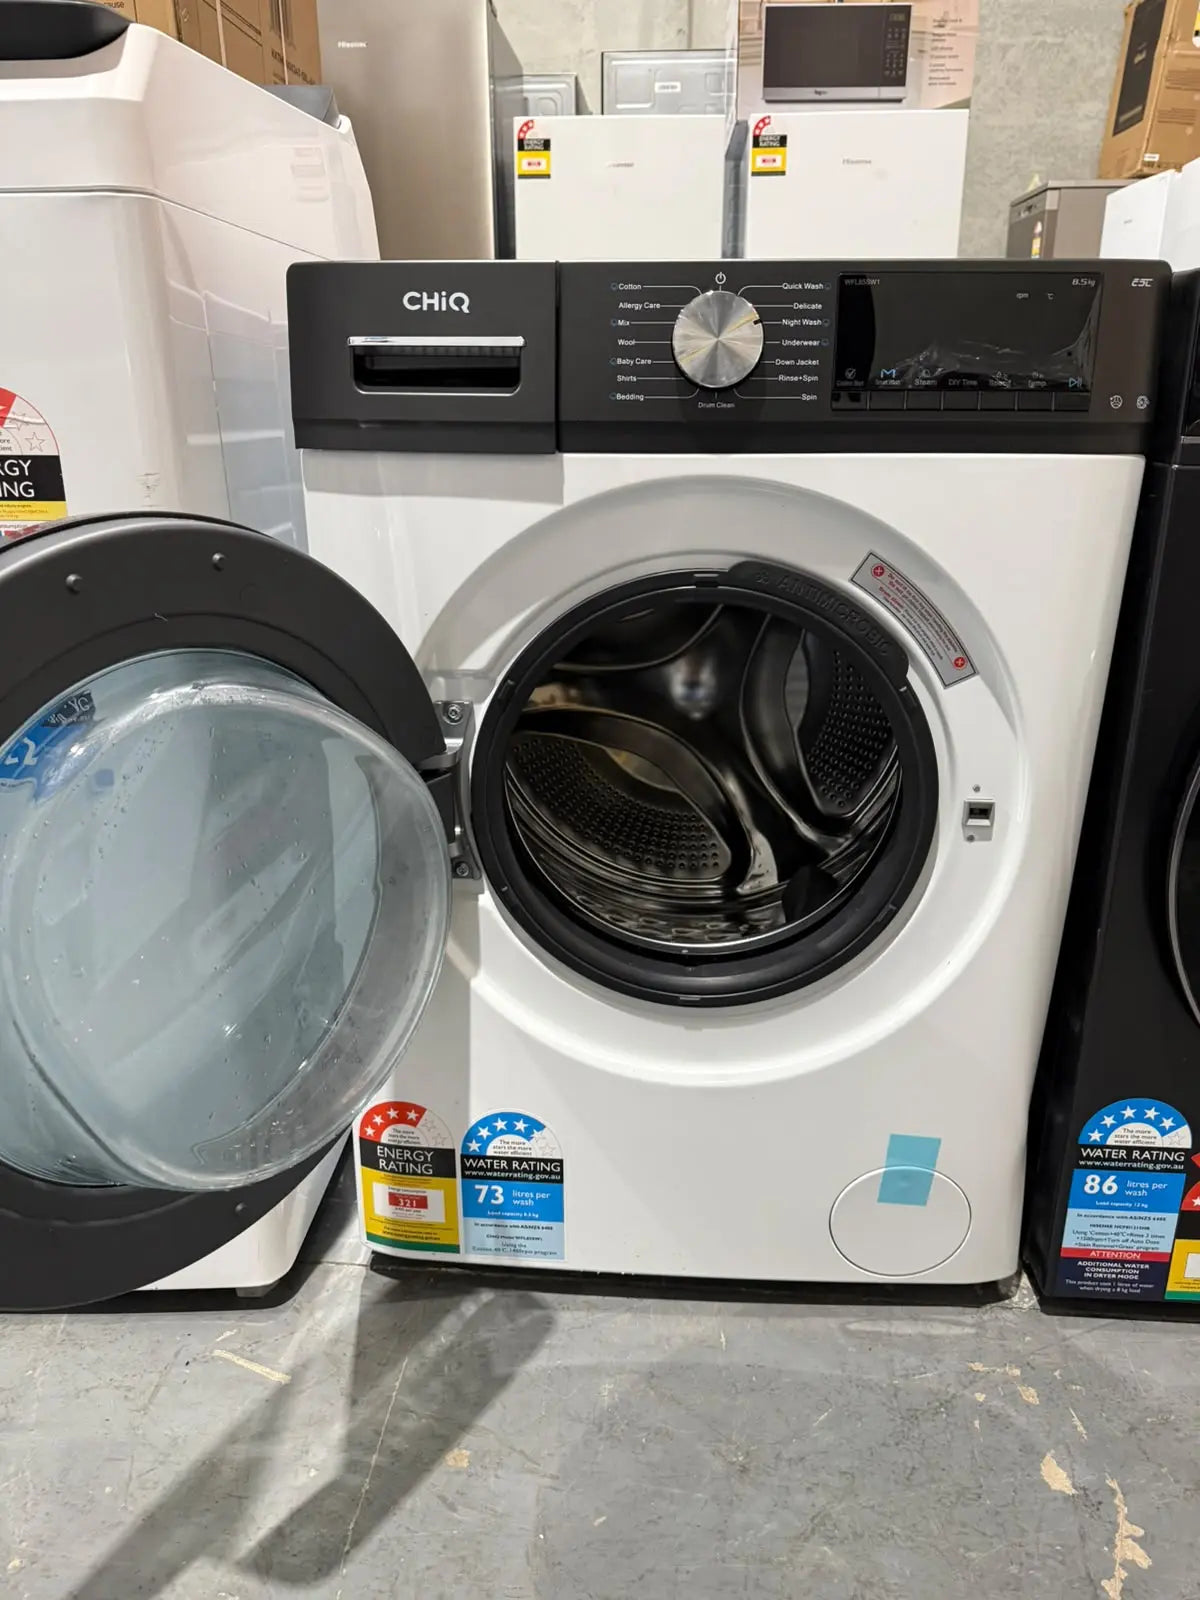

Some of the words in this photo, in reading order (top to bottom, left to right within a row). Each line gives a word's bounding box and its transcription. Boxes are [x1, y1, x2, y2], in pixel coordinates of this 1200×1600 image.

[782, 282, 802, 290] Quick
[402, 291, 470, 313] CHiQ
[618, 302, 644, 310] Allergy
[782, 319, 802, 327] Night
[616, 358, 634, 366] Baby
[616, 393, 644, 401] Bedding
[377, 1145, 434, 1162] ENERGY
[1081, 1148, 1127, 1159] WATER
[1132, 1150, 1185, 1161] RATING
[379, 1159, 433, 1175] RATING
[464, 1158, 508, 1170] WATER
[513, 1160, 560, 1172] RATING
[1079, 1160, 1184, 1170] www.waterrating.gov.au
[464, 1171, 560, 1180] www.waterrating.gov.au
[1084, 1174, 1118, 1195] 86
[1127, 1180, 1149, 1188] litres
[474, 1185, 504, 1205] 73
[512, 1189, 534, 1198] litres
[1090, 1250, 1141, 1259] ATTENTION
